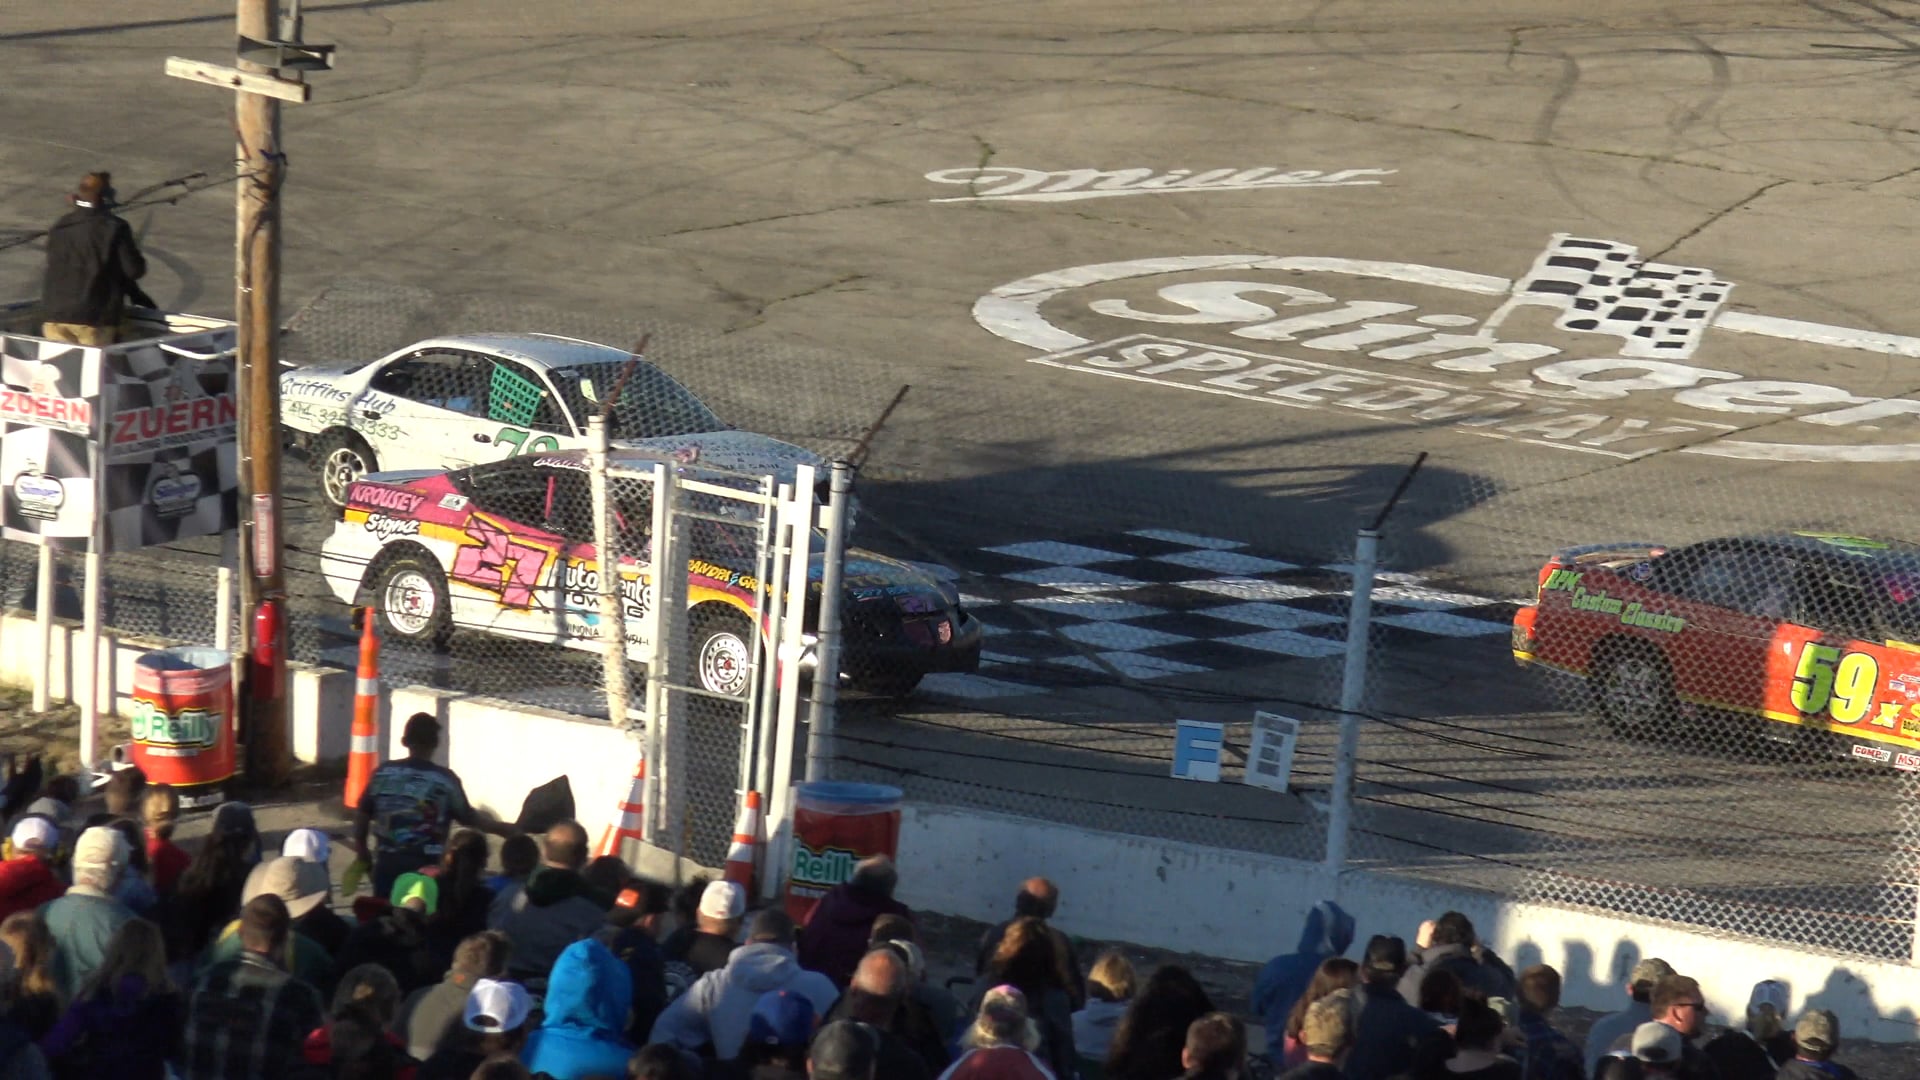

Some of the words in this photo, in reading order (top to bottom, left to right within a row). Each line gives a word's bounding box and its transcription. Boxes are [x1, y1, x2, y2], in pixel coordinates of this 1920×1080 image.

[924, 166, 1398, 202] Miller
[0, 391, 91, 425] ZUERN
[280, 377, 352, 402] Griffins
[355, 388, 397, 415] Hub
[1083, 343, 1700, 446] SPEEDWAY
[112, 394, 237, 443] ZUERN
[351, 484, 424, 513] KROUSEY
[1174, 724, 1222, 777] F
